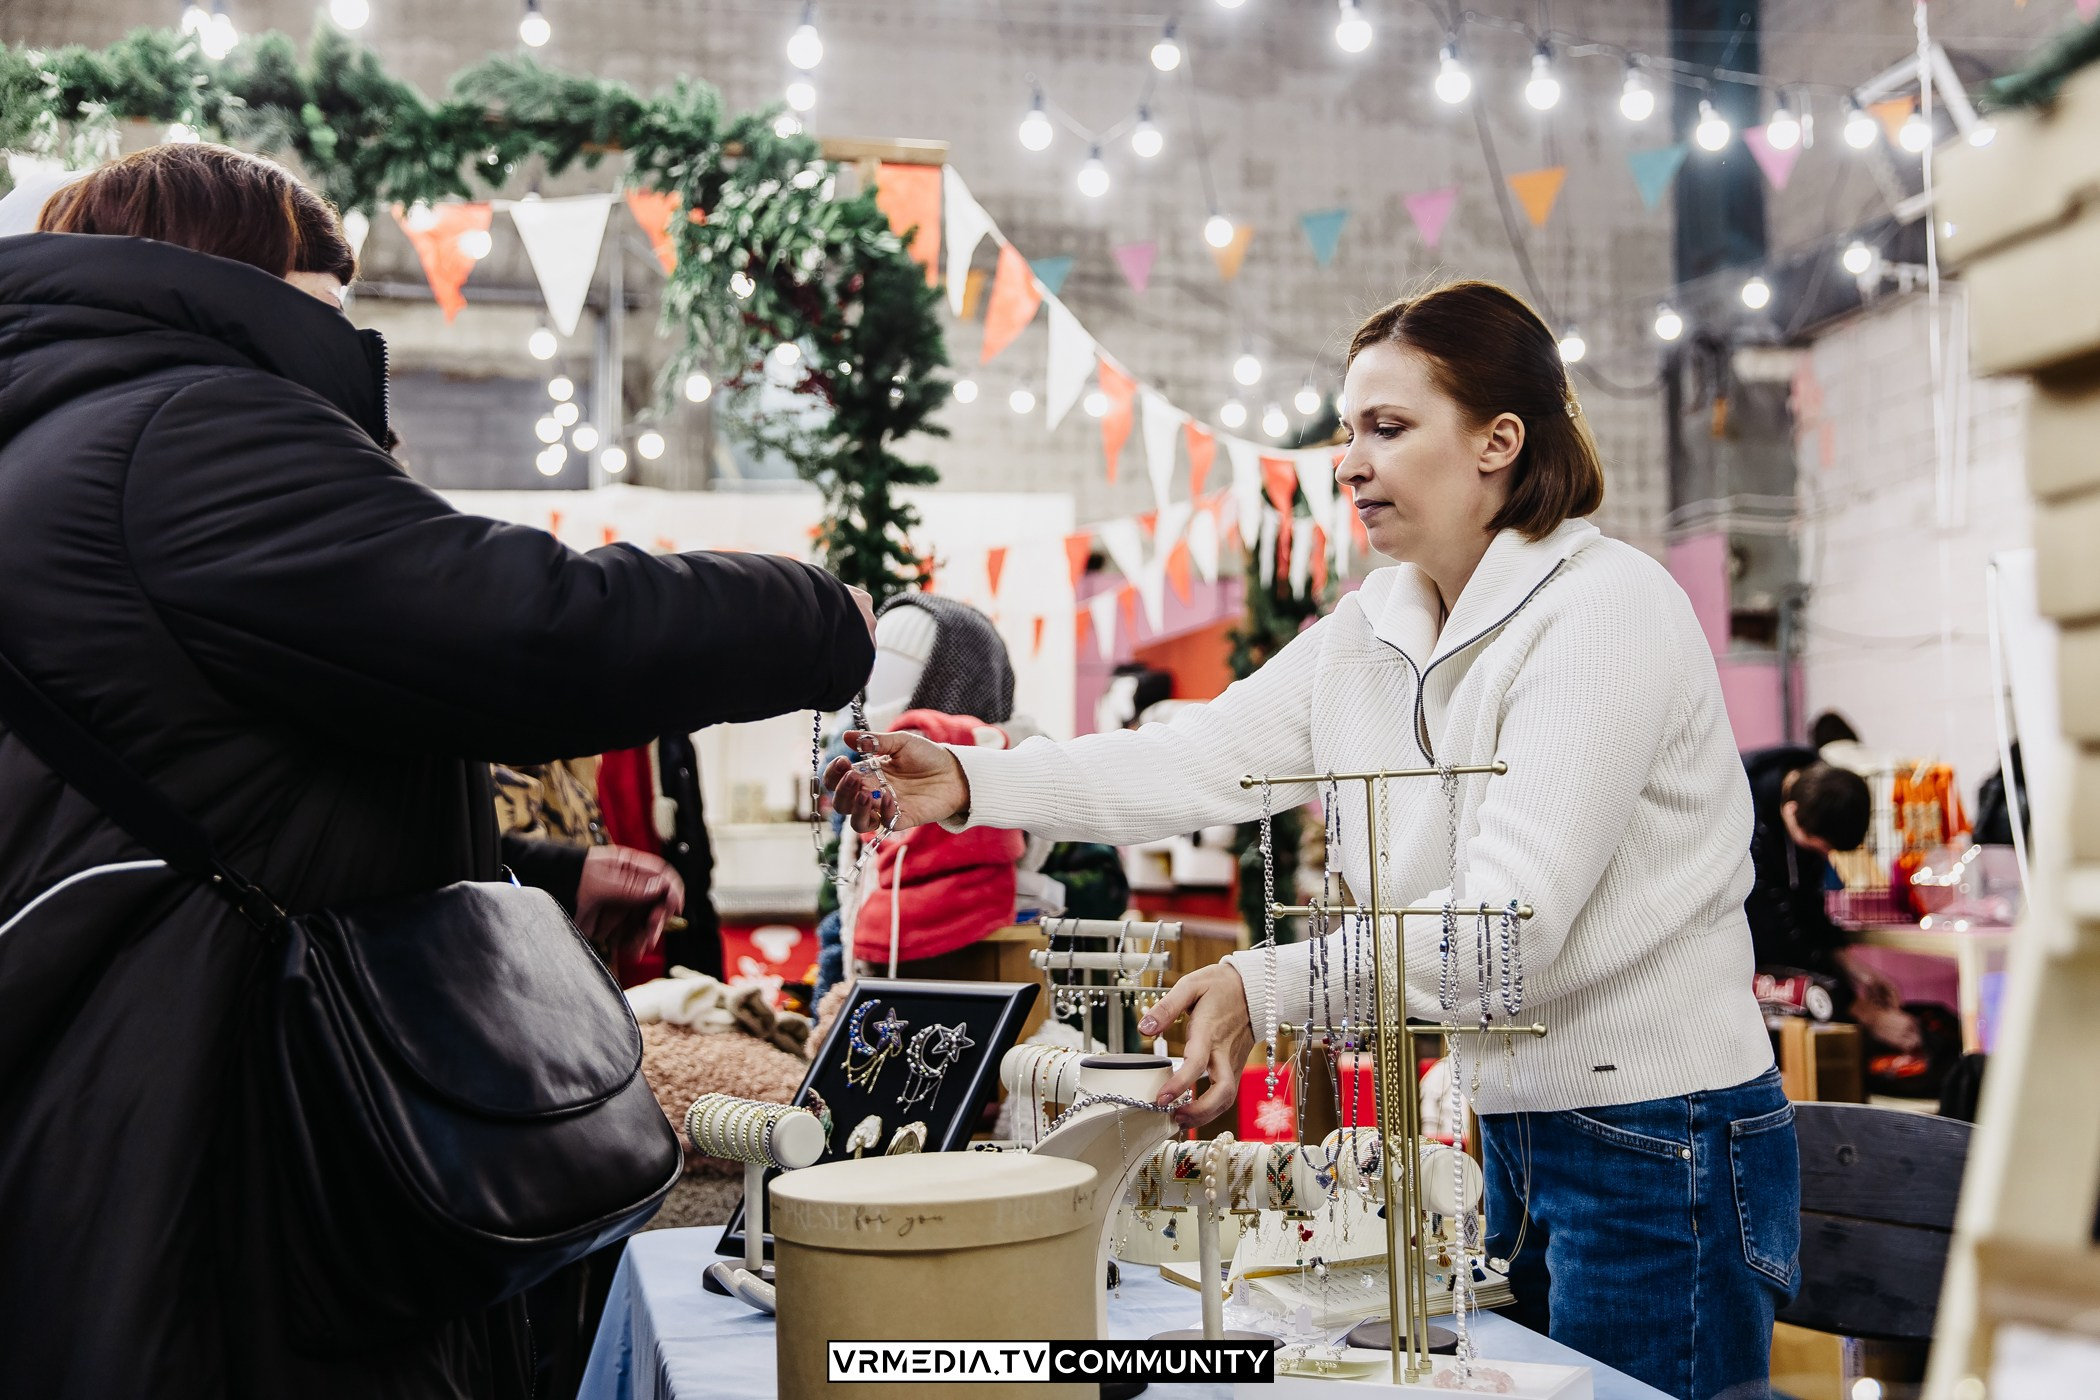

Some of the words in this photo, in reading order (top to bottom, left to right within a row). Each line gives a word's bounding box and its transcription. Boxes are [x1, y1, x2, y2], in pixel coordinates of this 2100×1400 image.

[784, 1201, 889, 1232] PRESENT
[855, 1204, 892, 1231] for
[898, 1214, 943, 1236] you
[996, 1192, 1072, 1227] PRES
